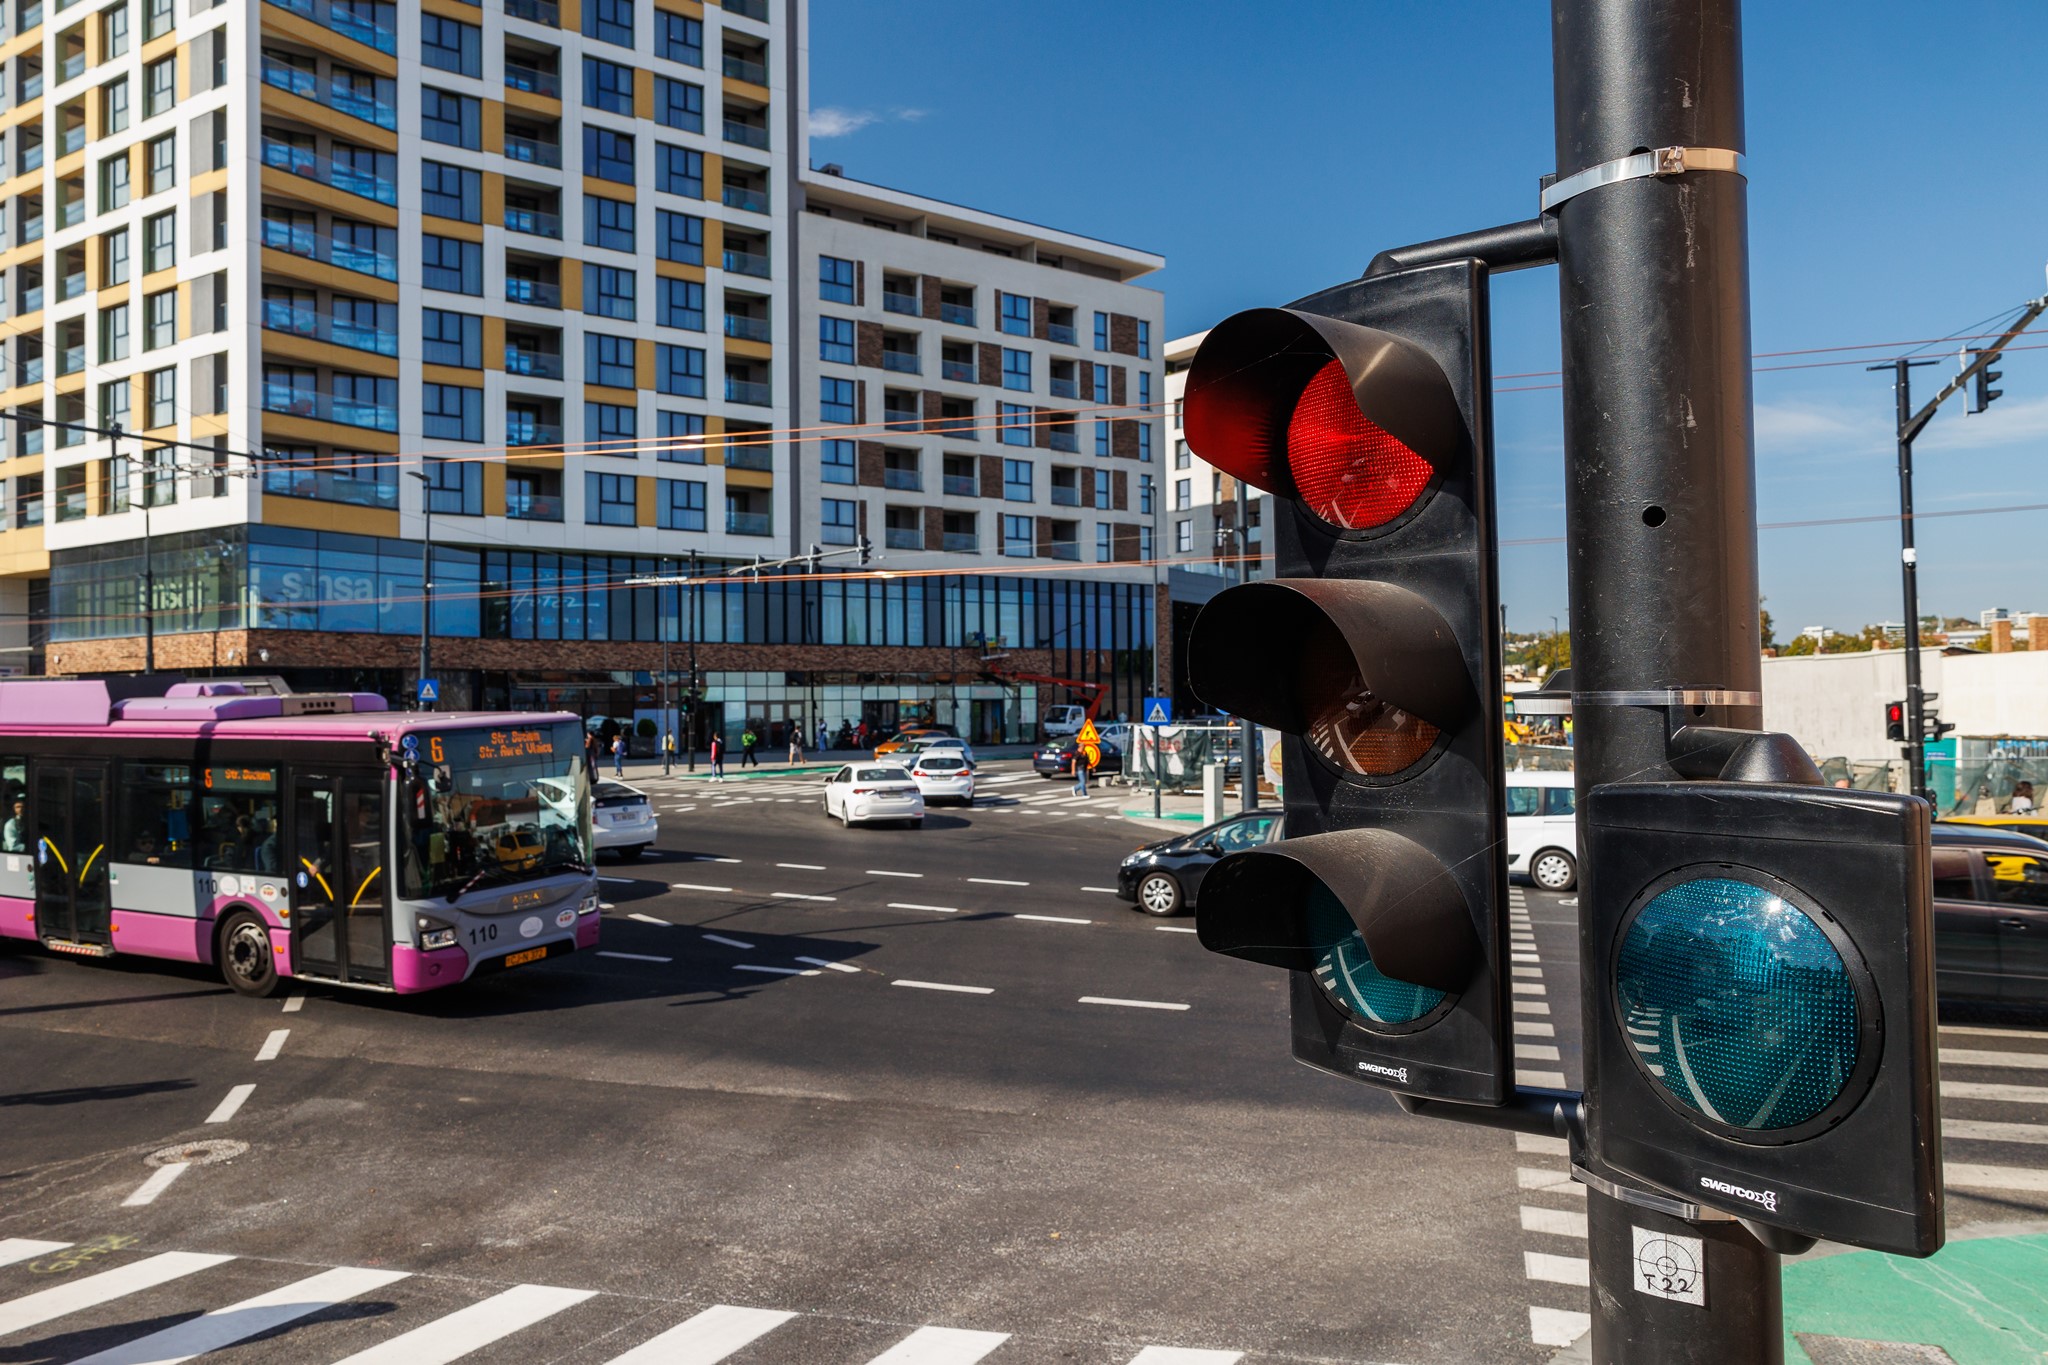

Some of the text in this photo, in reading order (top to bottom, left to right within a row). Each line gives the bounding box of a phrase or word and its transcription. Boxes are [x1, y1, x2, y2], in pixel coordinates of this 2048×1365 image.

[282, 564, 393, 613] sinsay
[430, 736, 444, 763] 6
[479, 745, 498, 759] Str.
[198, 878, 218, 895] 110
[469, 924, 498, 945] 110
[1358, 1062, 1394, 1076] swarco
[1700, 1177, 1756, 1201] swarco
